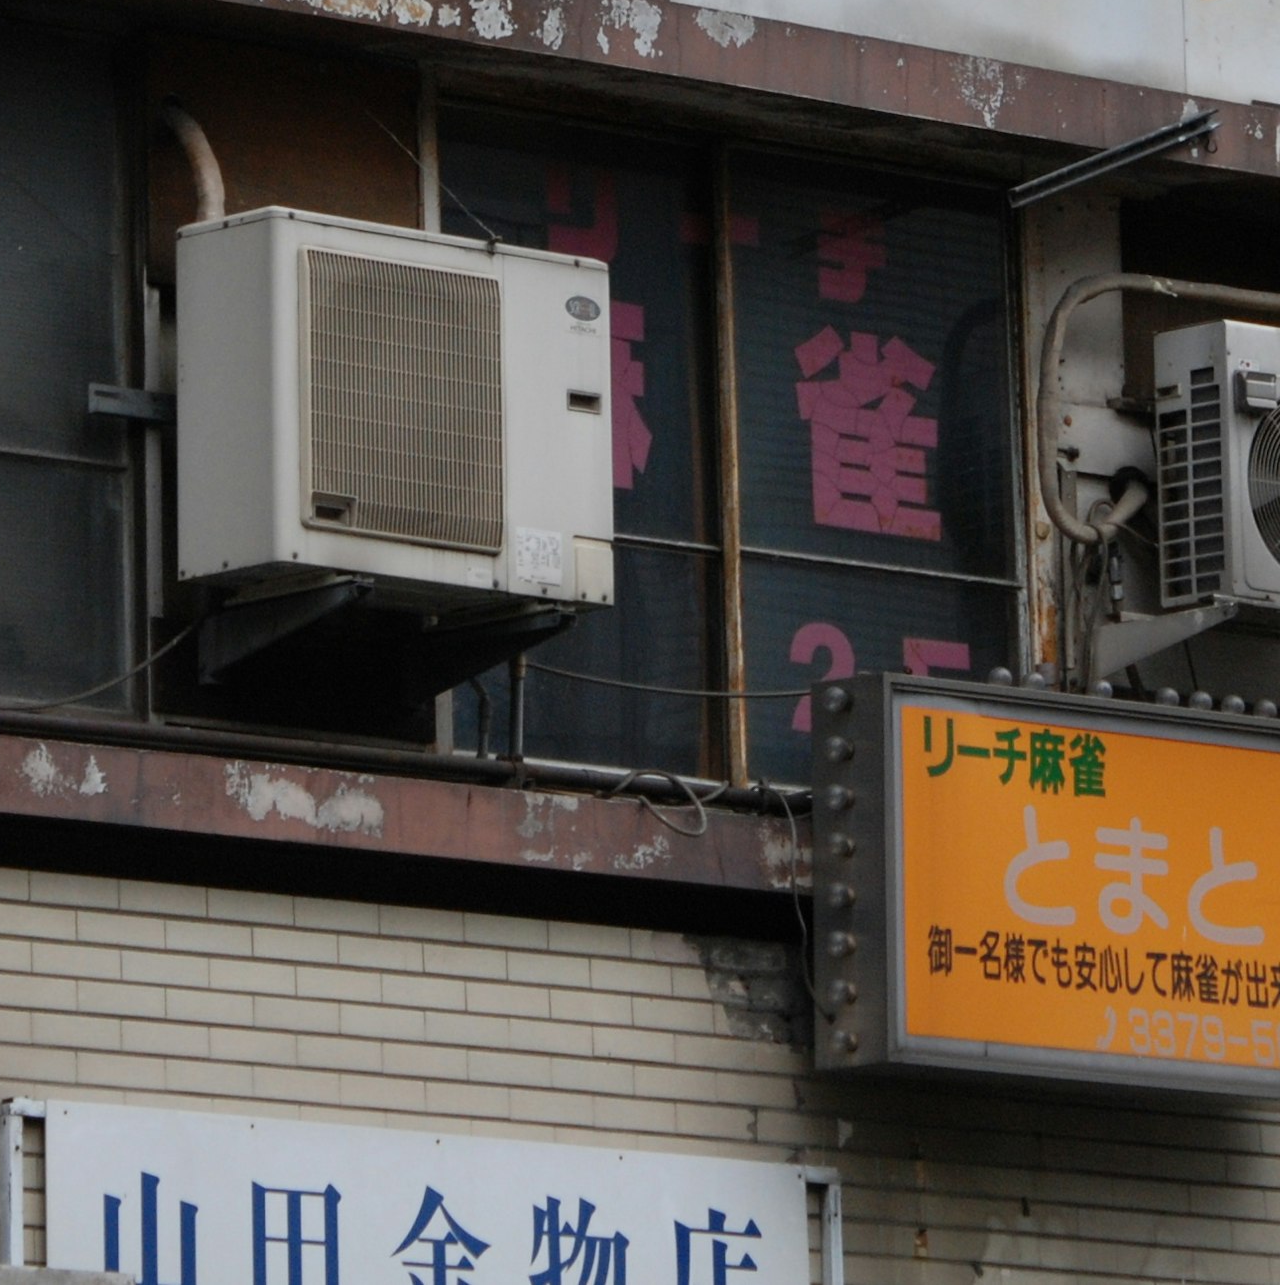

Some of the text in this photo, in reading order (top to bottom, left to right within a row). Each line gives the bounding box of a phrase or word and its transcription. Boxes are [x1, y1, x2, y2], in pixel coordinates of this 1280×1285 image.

[922, 715, 1107, 799] リーチ麻雀
[1003, 804, 1266, 947] とまと
